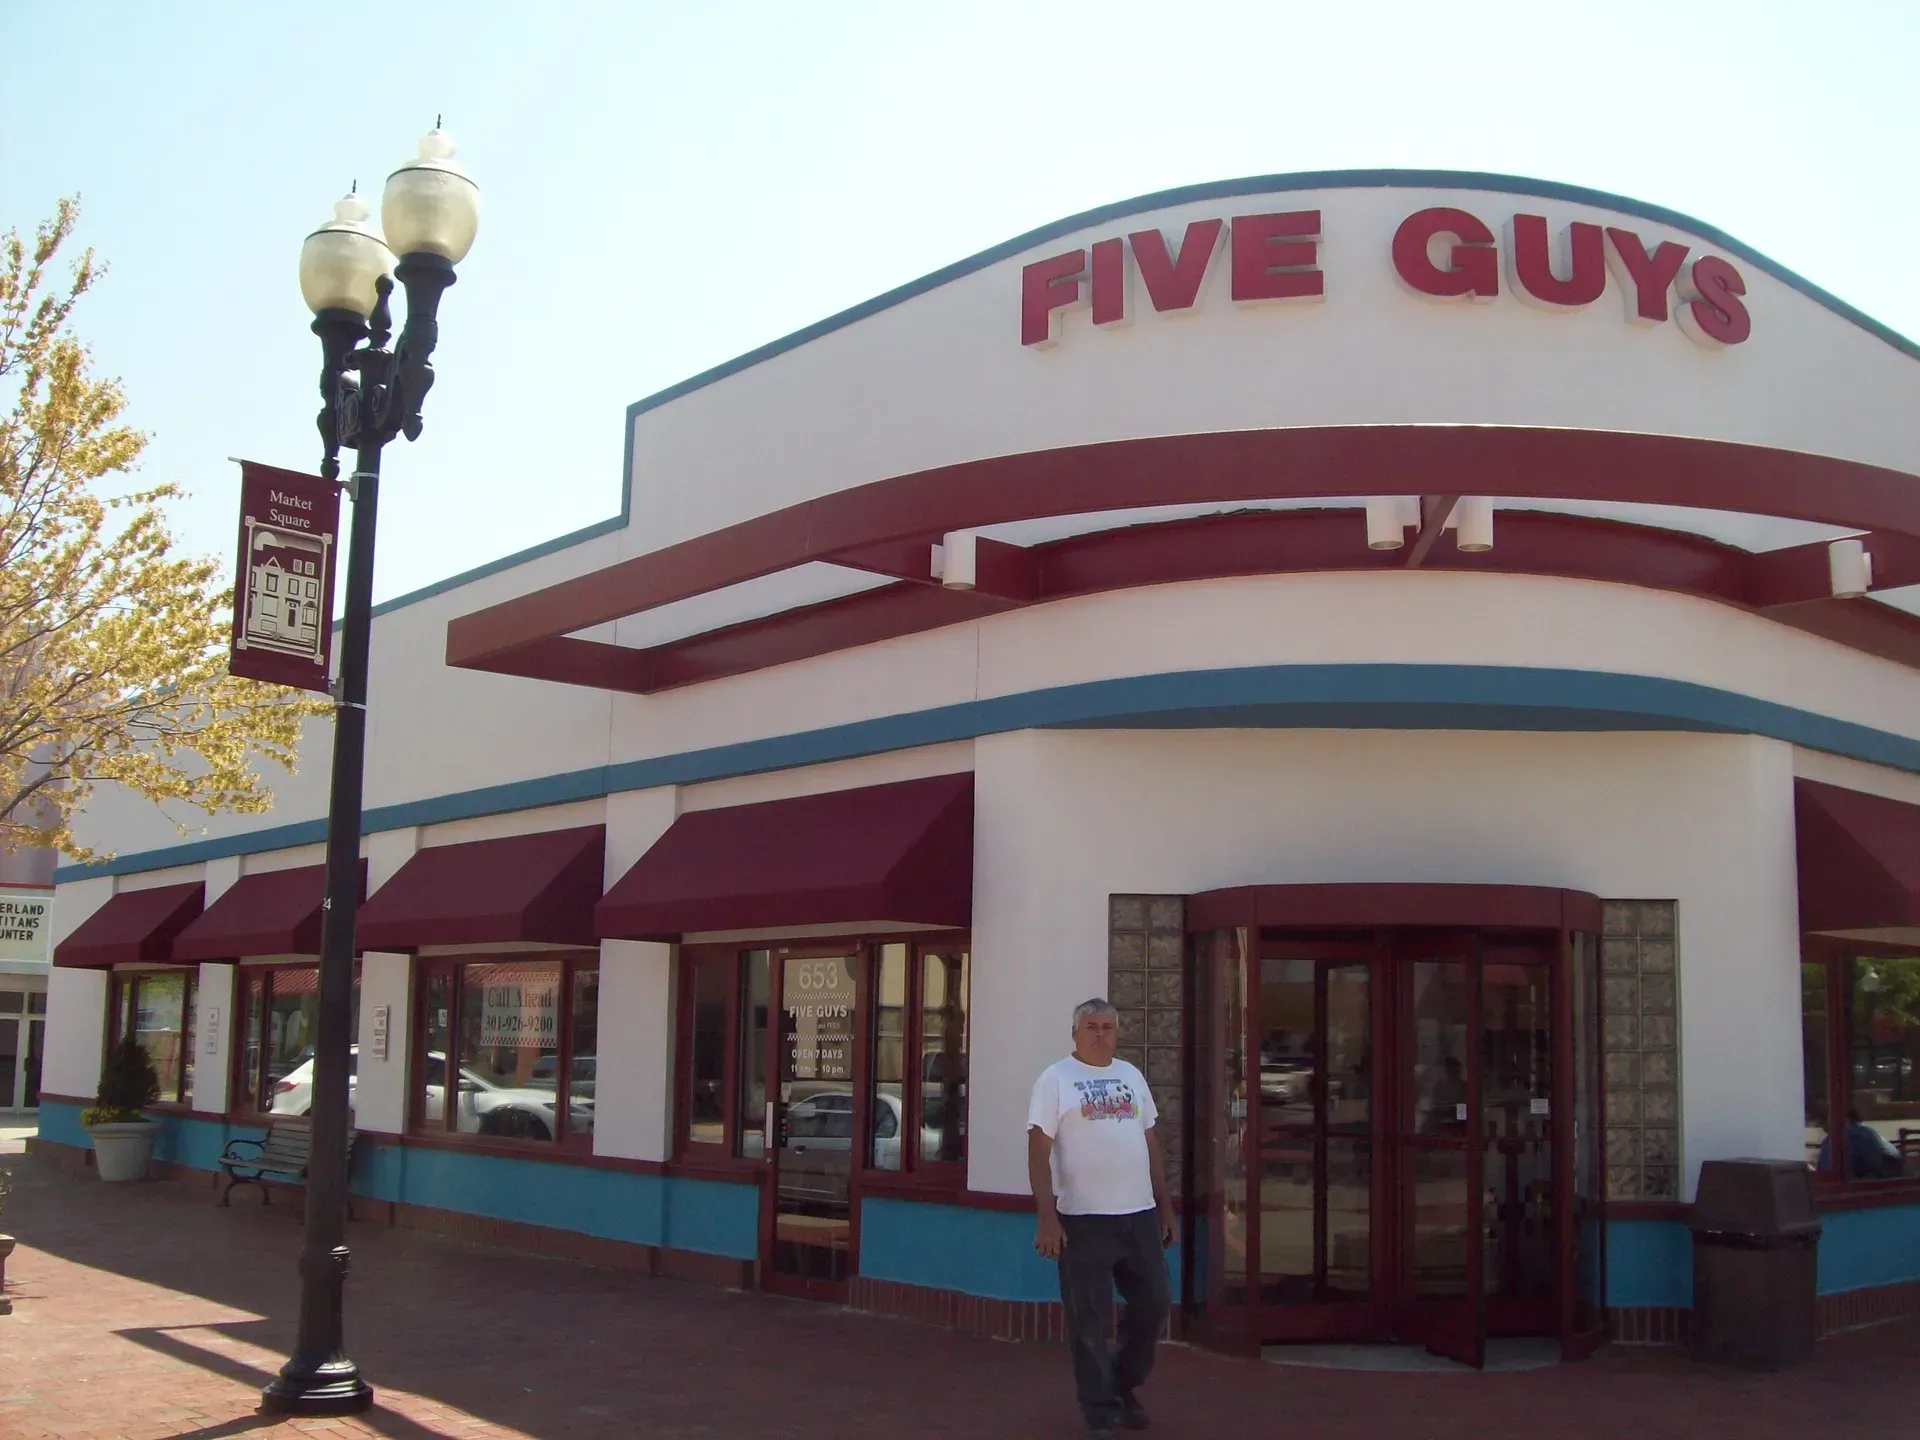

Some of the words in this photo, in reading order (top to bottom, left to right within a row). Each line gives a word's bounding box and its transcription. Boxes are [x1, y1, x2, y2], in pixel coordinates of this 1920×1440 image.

[1021, 209, 1324, 347] FIVE
[1391, 206, 1751, 347] GUYS
[269, 489, 313, 510] Market
[269, 508, 311, 528] Square
[0, 902, 44, 916] ERLAND
[799, 961, 838, 990] 653
[488, 986, 510, 1008] Call
[514, 986, 552, 1008] Ahead
[789, 1006, 814, 1018] FIVE
[816, 1005, 848, 1018] GUYS
[484, 1015, 553, 1032] 301-926-9200
[792, 1048, 814, 1059] OPEN
[815, 1049, 820, 1059] 7
[822, 1049, 843, 1059] DAYS
[790, 1064, 798, 1073] 11
[822, 1064, 830, 1074] 10
[832, 1066, 844, 1074] pm
